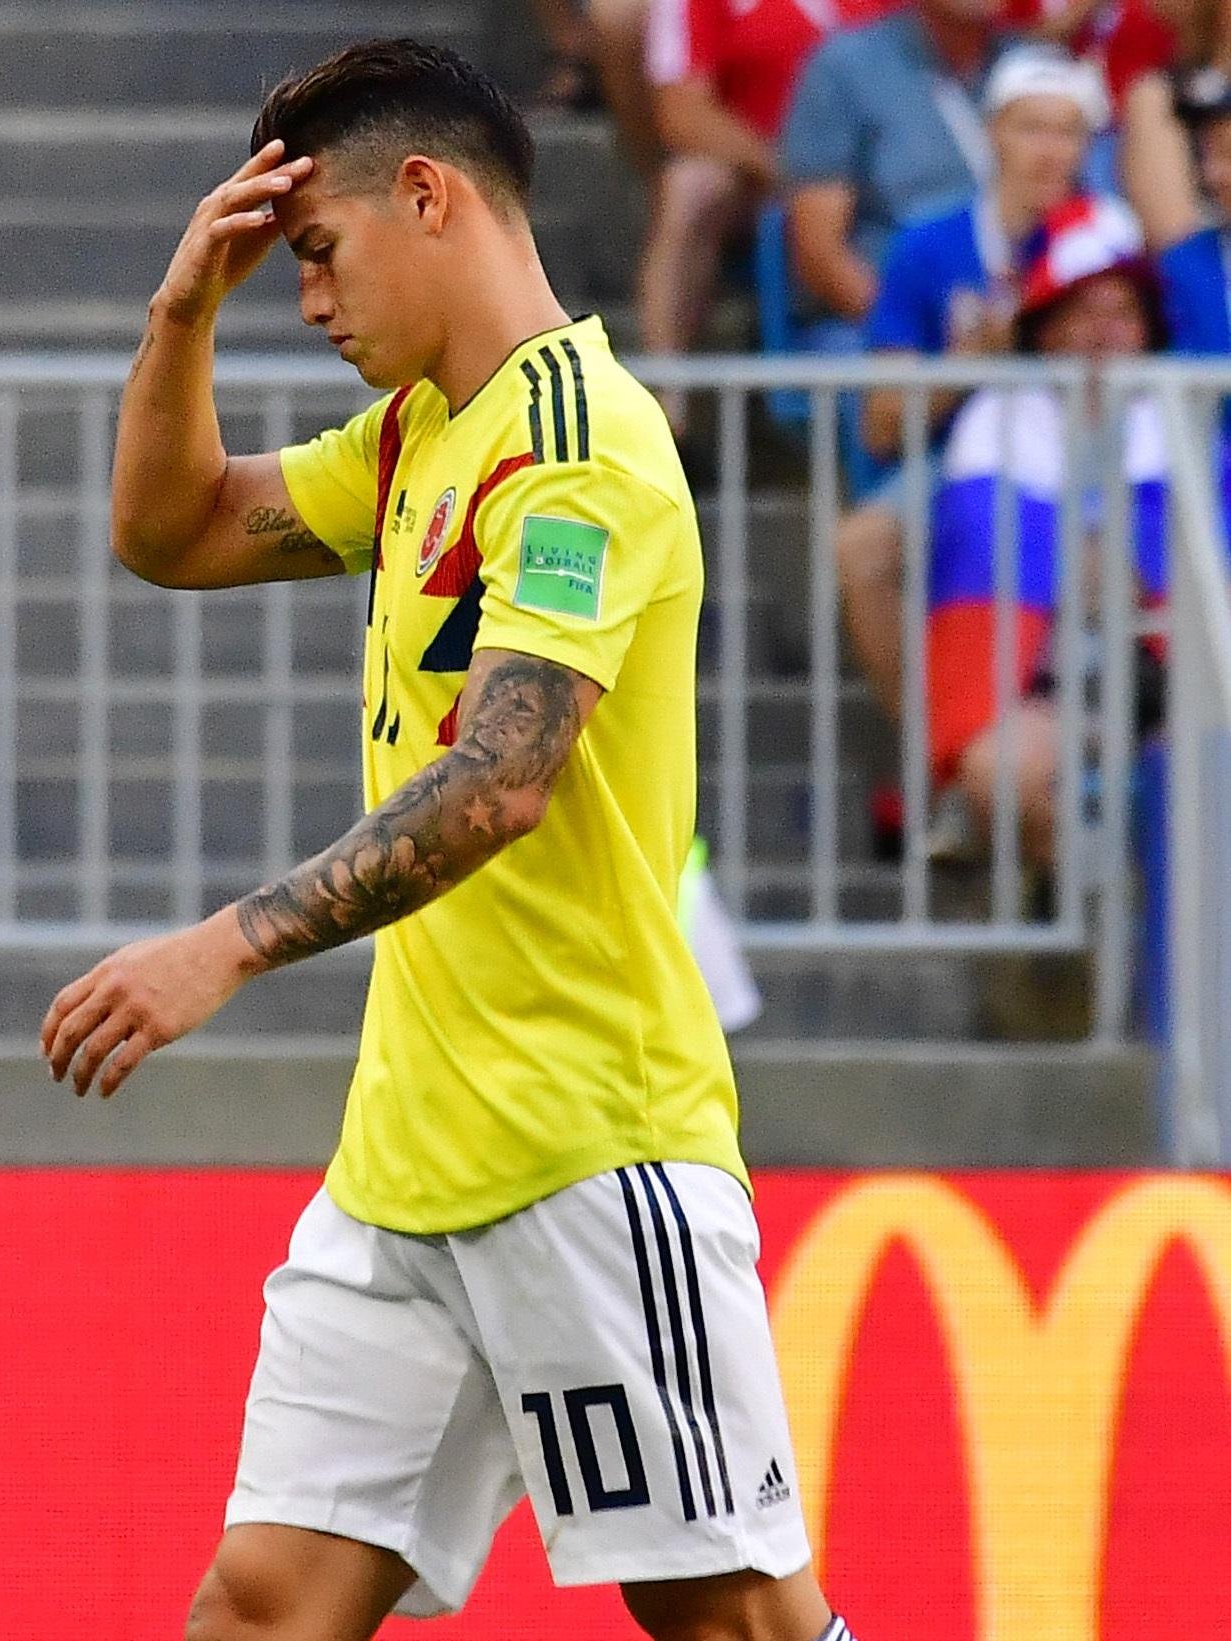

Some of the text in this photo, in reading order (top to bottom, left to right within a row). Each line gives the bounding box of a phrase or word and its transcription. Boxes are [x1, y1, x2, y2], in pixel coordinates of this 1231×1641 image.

[527, 545, 597, 566] LIVING
[527, 556, 595, 575] FOOTBALL
[569, 579, 594, 595] FIFA
[521, 1383, 651, 1517] 10
